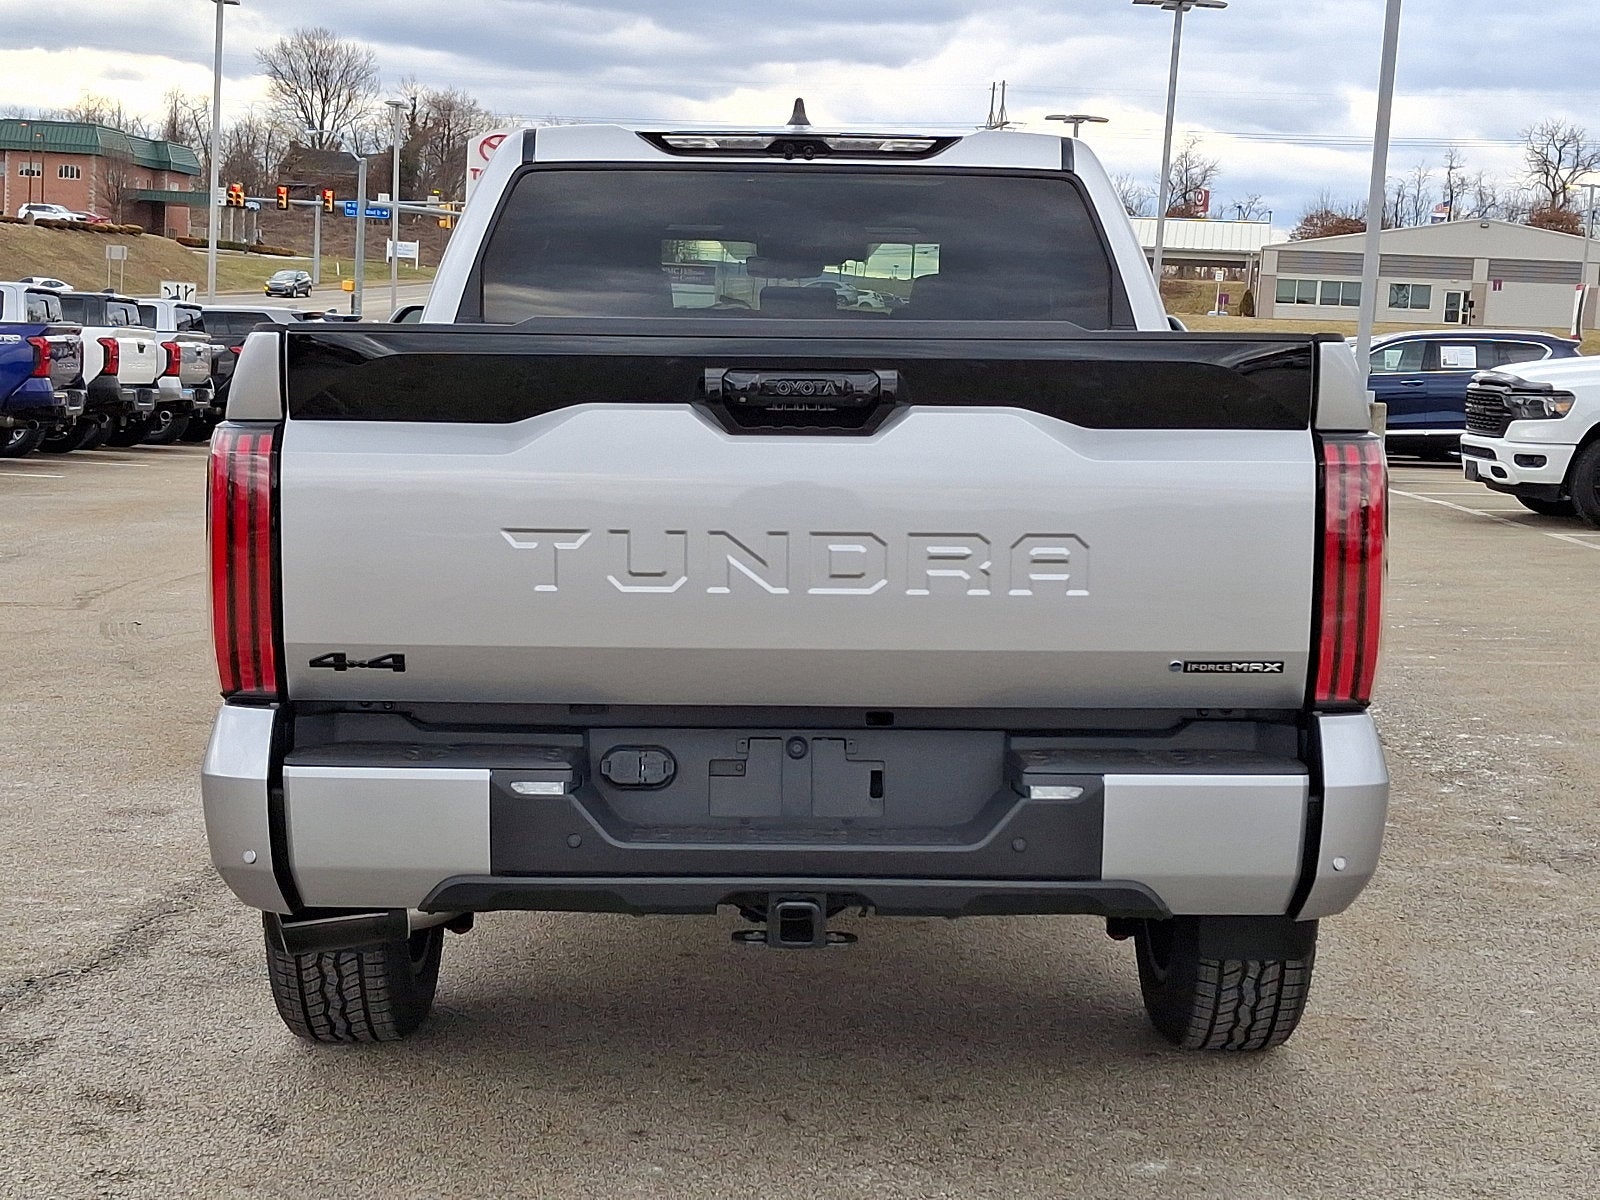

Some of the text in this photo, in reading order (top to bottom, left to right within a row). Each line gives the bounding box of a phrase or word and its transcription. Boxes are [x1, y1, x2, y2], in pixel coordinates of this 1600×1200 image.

[764, 380, 838, 396] TOYOTA
[500, 527, 1090, 597] TUNDRA
[308, 652, 406, 672] 4x4
